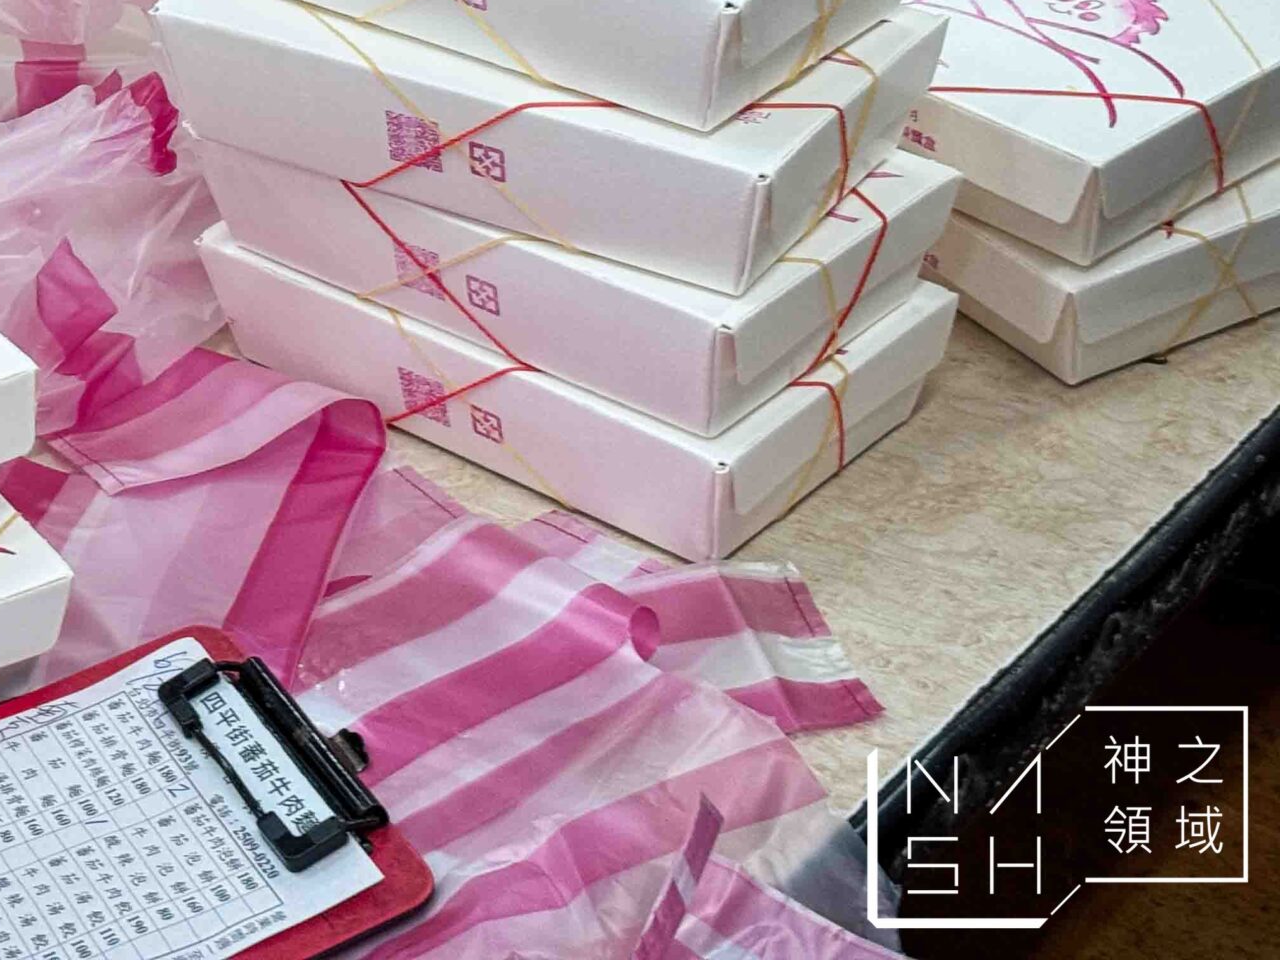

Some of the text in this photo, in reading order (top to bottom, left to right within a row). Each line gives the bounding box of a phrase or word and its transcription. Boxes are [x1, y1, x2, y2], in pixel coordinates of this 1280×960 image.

[157, 764, 177, 783] 180
[131, 776, 151, 794] 180
[104, 787, 124, 806] 120
[77, 798, 98, 816] 100
[50, 808, 71, 826] 160
[23, 818, 44, 836] 160
[236, 871, 258, 890] 180
[209, 884, 230, 902] 100
[156, 907, 173, 920] 80
[182, 896, 203, 913] 160
[126, 915, 148, 934] 190
[99, 927, 120, 946] 110
[70, 939, 91, 960] 100
